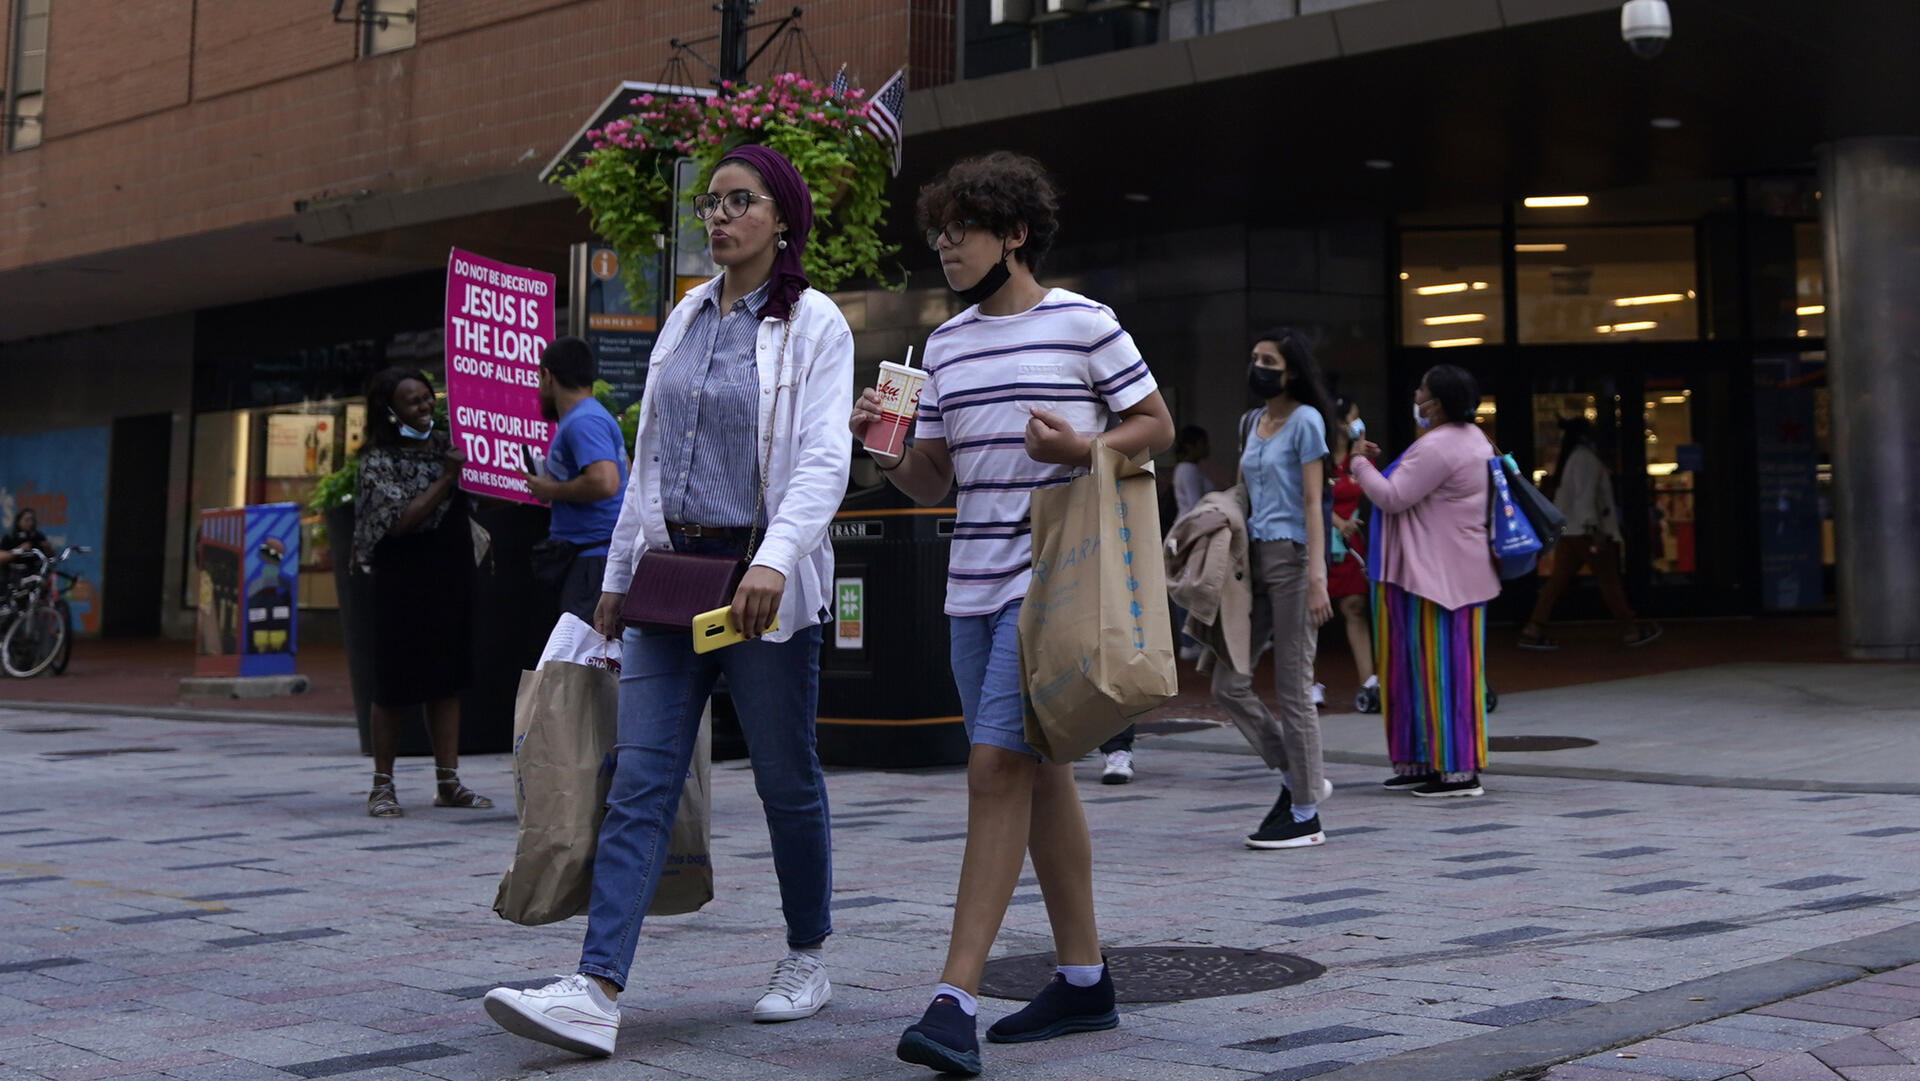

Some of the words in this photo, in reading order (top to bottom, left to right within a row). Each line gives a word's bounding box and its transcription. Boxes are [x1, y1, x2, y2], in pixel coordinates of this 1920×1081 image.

[455, 259, 468, 277] DO
[470, 264, 488, 282] NOT
[489, 270, 500, 286] BE
[501, 273, 548, 297] DECEIVED
[461, 283, 516, 326] JESUS
[520, 297, 539, 330] IS
[589, 316, 633, 327] SUMMER
[452, 316, 490, 355] THE
[494, 326, 548, 365] LORD
[453, 354, 478, 375] GOD
[479, 360, 494, 379] OF
[495, 364, 514, 384] ALL
[515, 367, 540, 388] FLES
[456, 406, 488, 430] GIVE
[488, 411, 522, 437] YOUR
[524, 419, 549, 442] LIFE
[461, 432, 490, 465] TO
[462, 468, 479, 483] FOR
[479, 471, 490, 486] HE
[490, 473, 497, 487] IS
[830, 523, 866, 537] TRASH
[687, 853, 706, 867] bag
